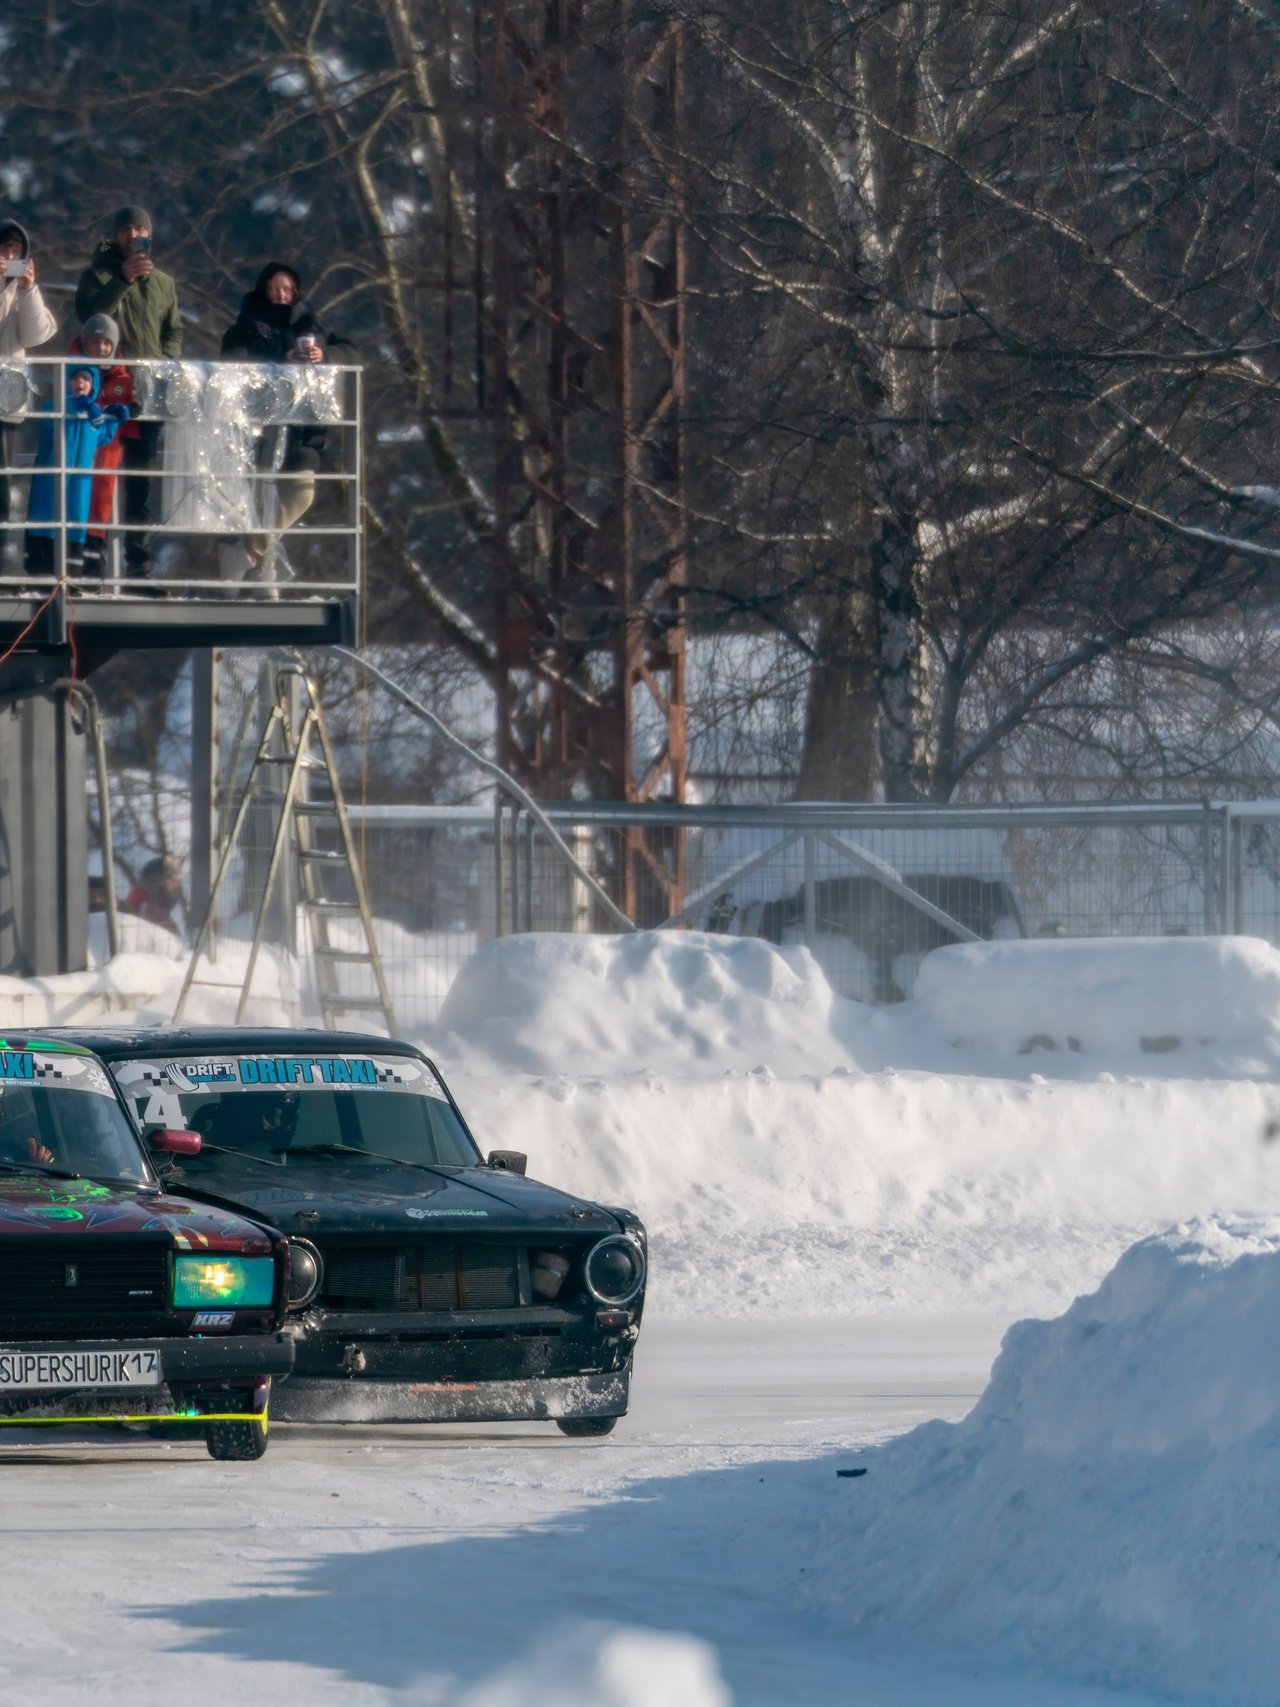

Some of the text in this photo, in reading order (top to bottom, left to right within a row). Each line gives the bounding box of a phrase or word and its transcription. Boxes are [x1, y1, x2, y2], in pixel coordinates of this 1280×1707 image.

[186, 1062, 233, 1076] DRIFT
[238, 1059, 378, 1084] DRIFT TAXI
[193, 1313, 233, 1326] KRZ
